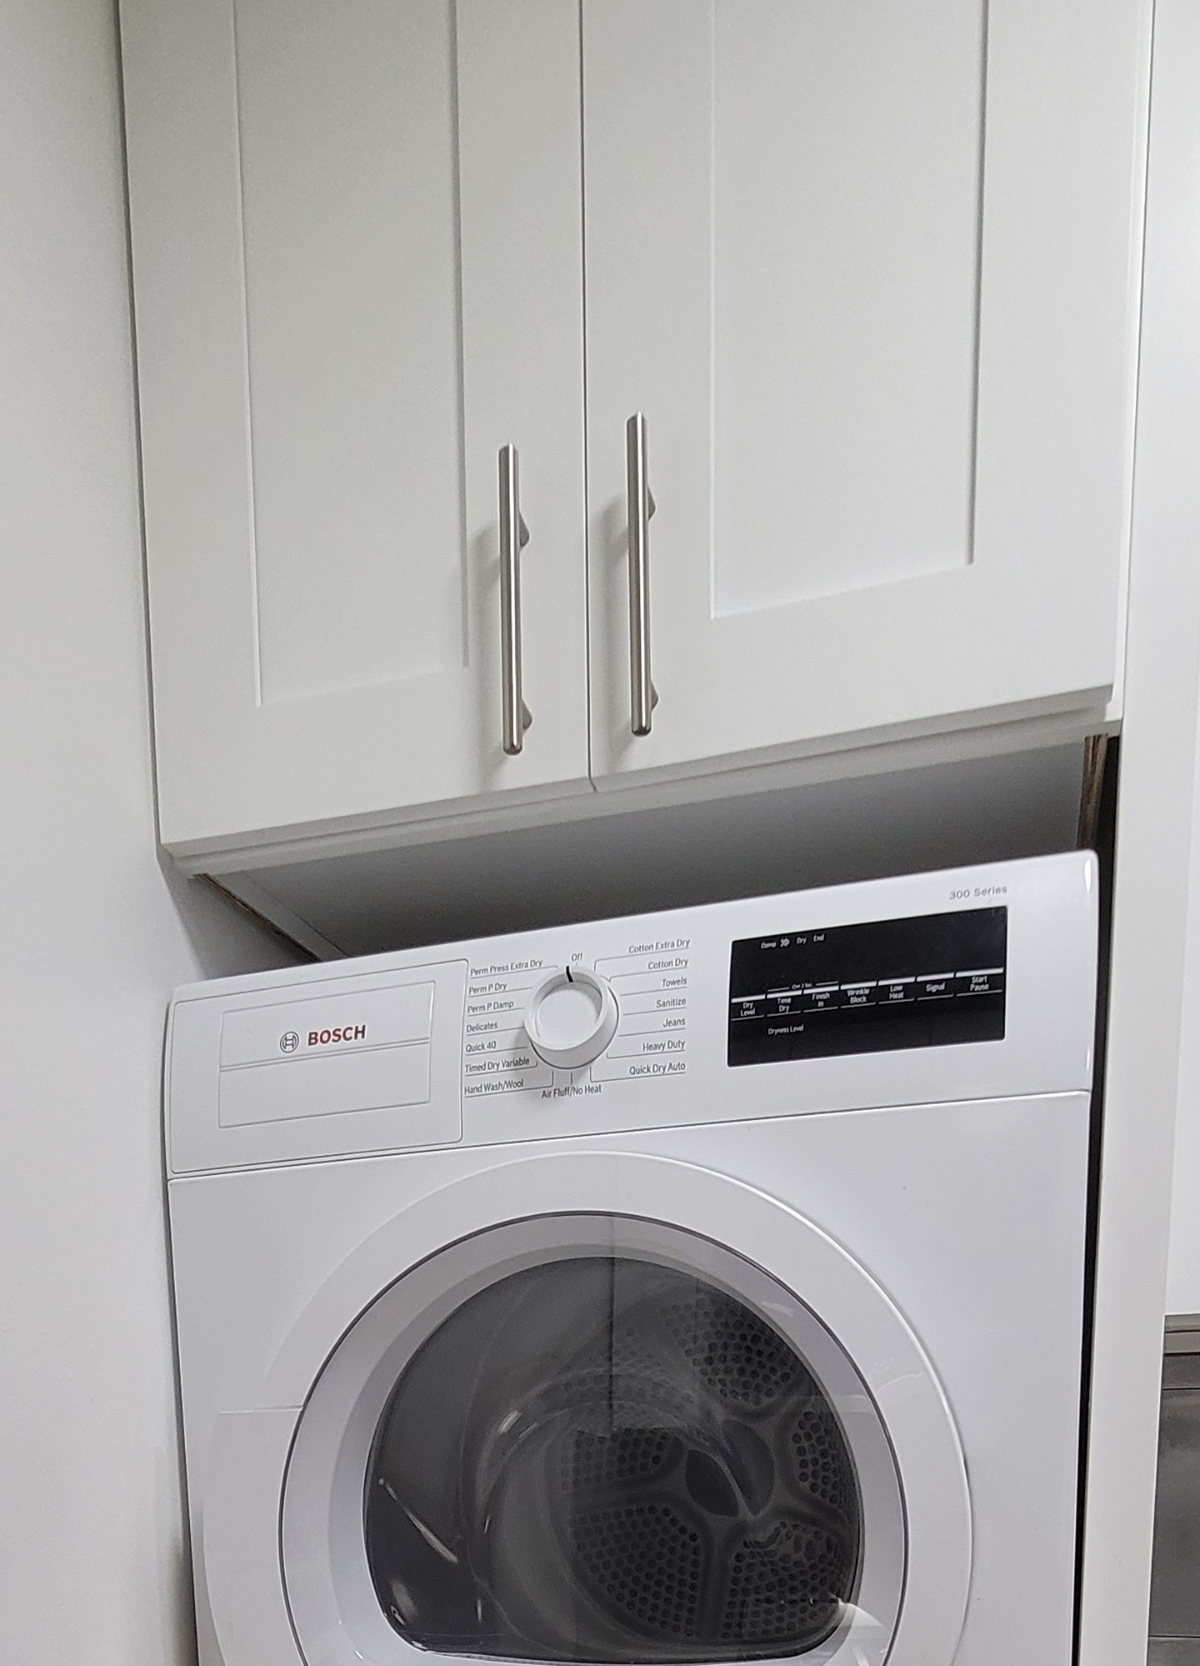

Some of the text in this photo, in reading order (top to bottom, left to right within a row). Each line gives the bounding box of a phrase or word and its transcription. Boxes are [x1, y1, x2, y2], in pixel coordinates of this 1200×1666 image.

[949, 884, 1008, 900] 300 Series
[628, 939, 690, 954] Cotton Extra Dry
[571, 952, 584, 962] Off
[470, 959, 543, 976] Perm Press Extra Dry
[648, 958, 689, 970] Cotton Dry
[662, 976, 687, 988] Towels
[926, 982, 946, 993] Signal
[970, 983, 989, 991] Pause
[468, 986, 487, 995] Perm
[494, 982, 507, 991] Dry
[890, 985, 903, 993] Low
[656, 998, 687, 1008] Sanitize
[850, 995, 867, 1004] Block
[467, 1005, 486, 1014] Perm
[493, 1001, 514, 1011] Damp
[743, 1002, 754, 1010] Dry
[779, 1005, 790, 1013] Dry
[740, 1008, 755, 1017] Level
[466, 1022, 498, 1033] Delicates
[663, 1018, 685, 1028] Jeans
[768, 1024, 804, 1035] Dryness Level
[307, 1025, 367, 1047] BOSCH
[465, 1040, 497, 1053] Quick 40
[642, 1040, 686, 1052] Heavy Duty
[465, 1057, 530, 1073] Timed Dry Variable
[629, 1061, 686, 1076] Quick Dry Auto
[464, 1079, 524, 1095] Hand Wash/Wool
[541, 1084, 602, 1099] Air Fluff/No Heat
